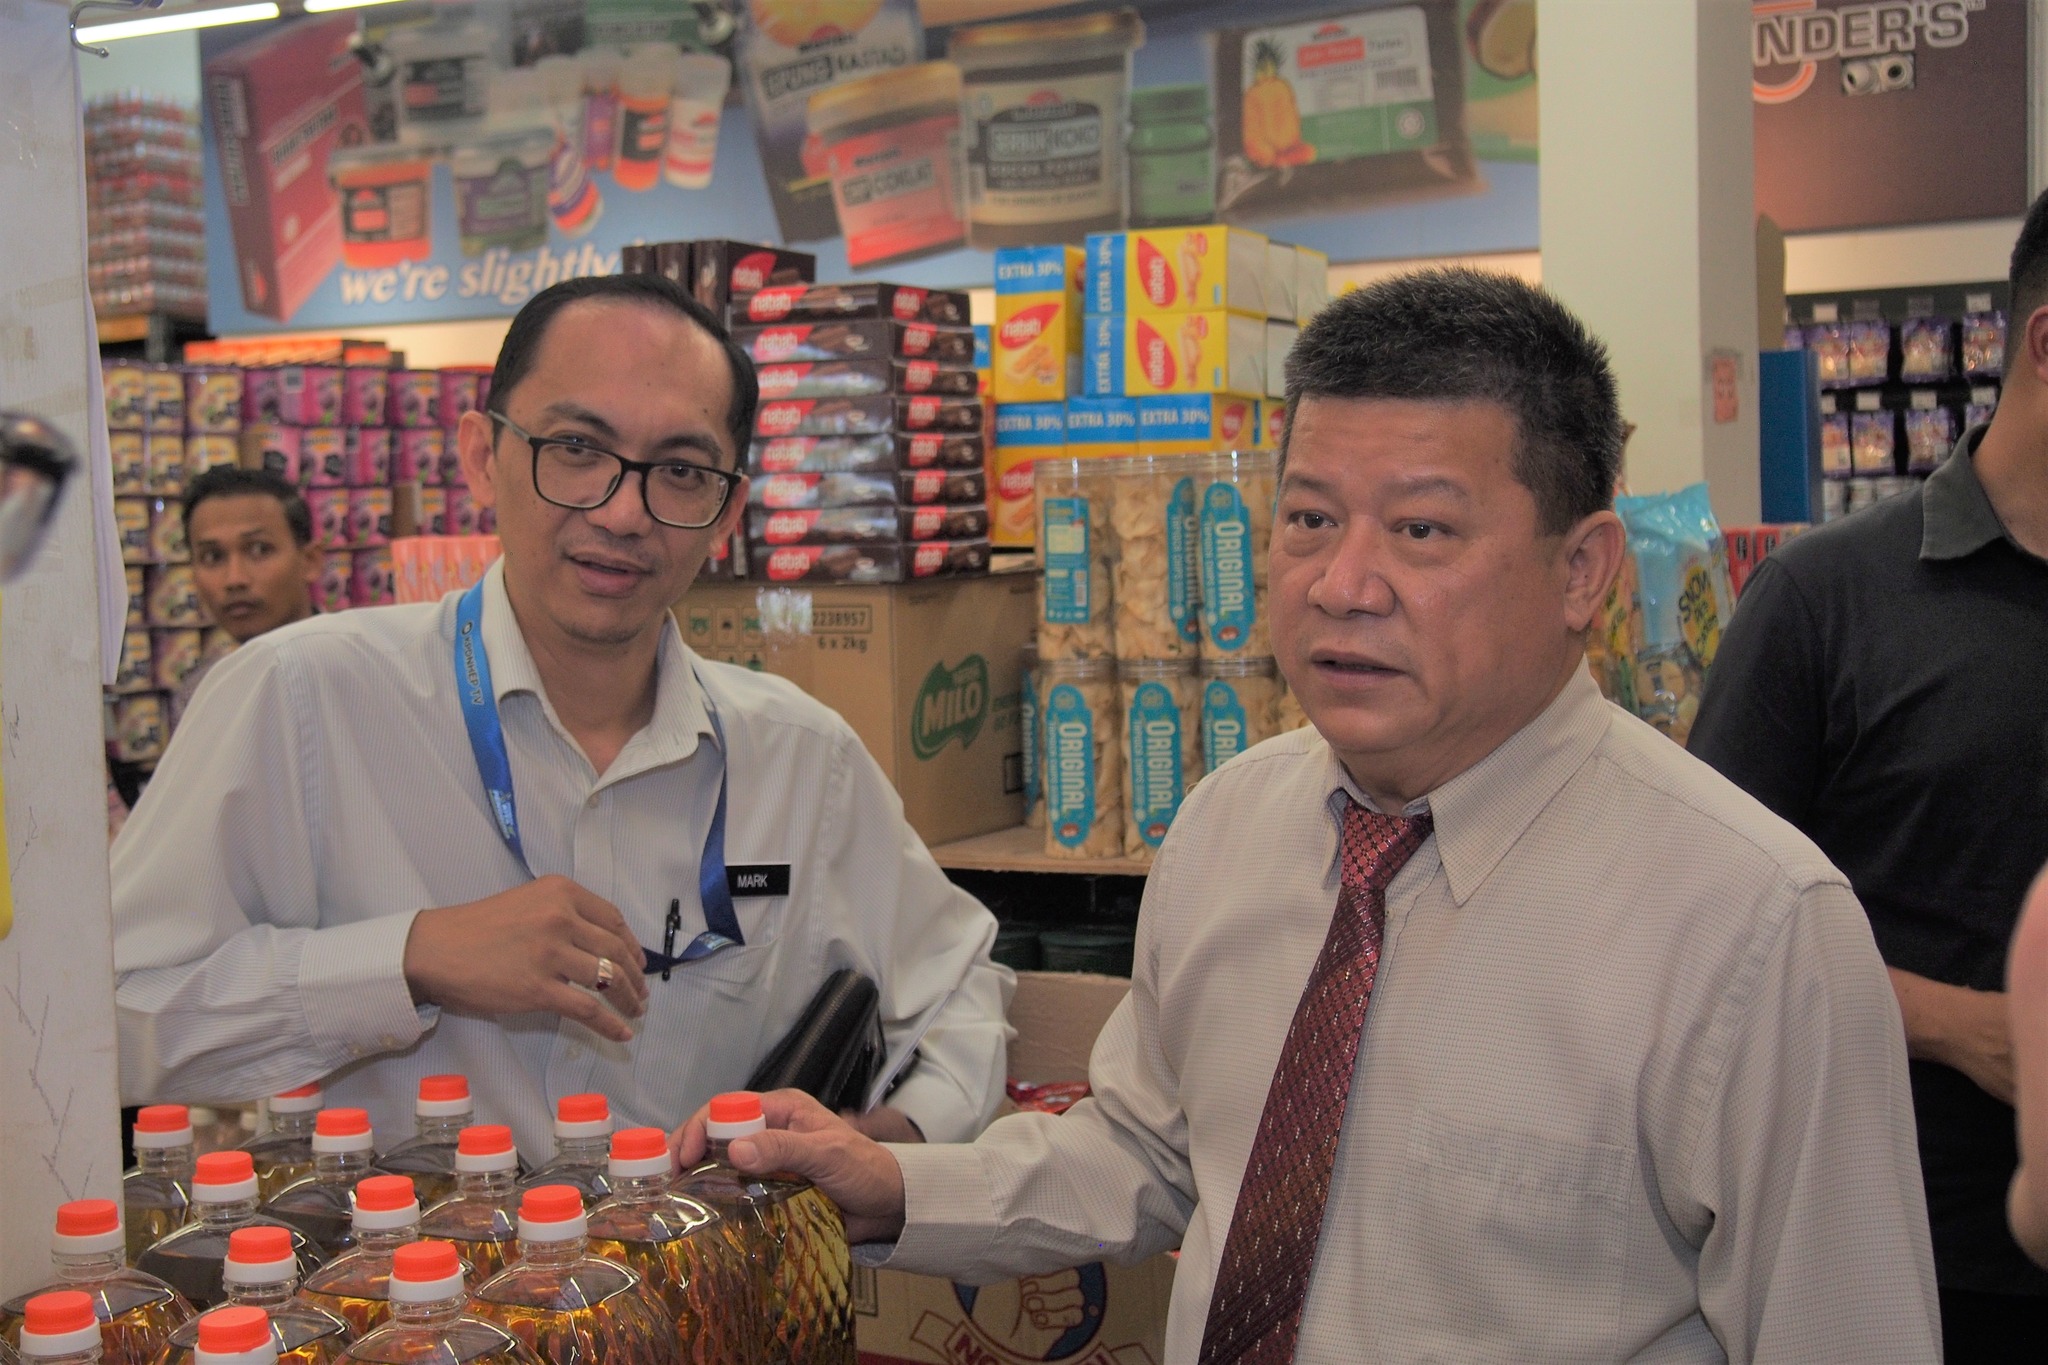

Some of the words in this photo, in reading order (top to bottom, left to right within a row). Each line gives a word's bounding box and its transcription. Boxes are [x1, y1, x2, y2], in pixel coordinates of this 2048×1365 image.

[1755, 0, 1969, 67] NDER'S
[1099, 237, 1113, 267] 30%
[340, 264, 449, 304] we're
[999, 262, 1034, 279] EXTRA
[1037, 260, 1064, 276] 30%
[1098, 271, 1112, 313] EXTRA
[1003, 318, 1041, 338] nabati
[1099, 319, 1112, 348] 30%
[1098, 354, 1112, 393] EXTRA
[999, 415, 1033, 432] EXTRA
[1036, 414, 1063, 431] 30%
[1069, 412, 1104, 428] EXTRA
[1107, 411, 1135, 427] 30%
[1141, 408, 1178, 425] EXTRA
[1181, 407, 1210, 423] 30%
[1215, 521, 1244, 617] ORIGINAL
[922, 681, 980, 738] MILO
[1059, 722, 1088, 815] ORIGINAL
[1146, 720, 1176, 814] ORIGINAL
[737, 874, 768, 888] MARK
